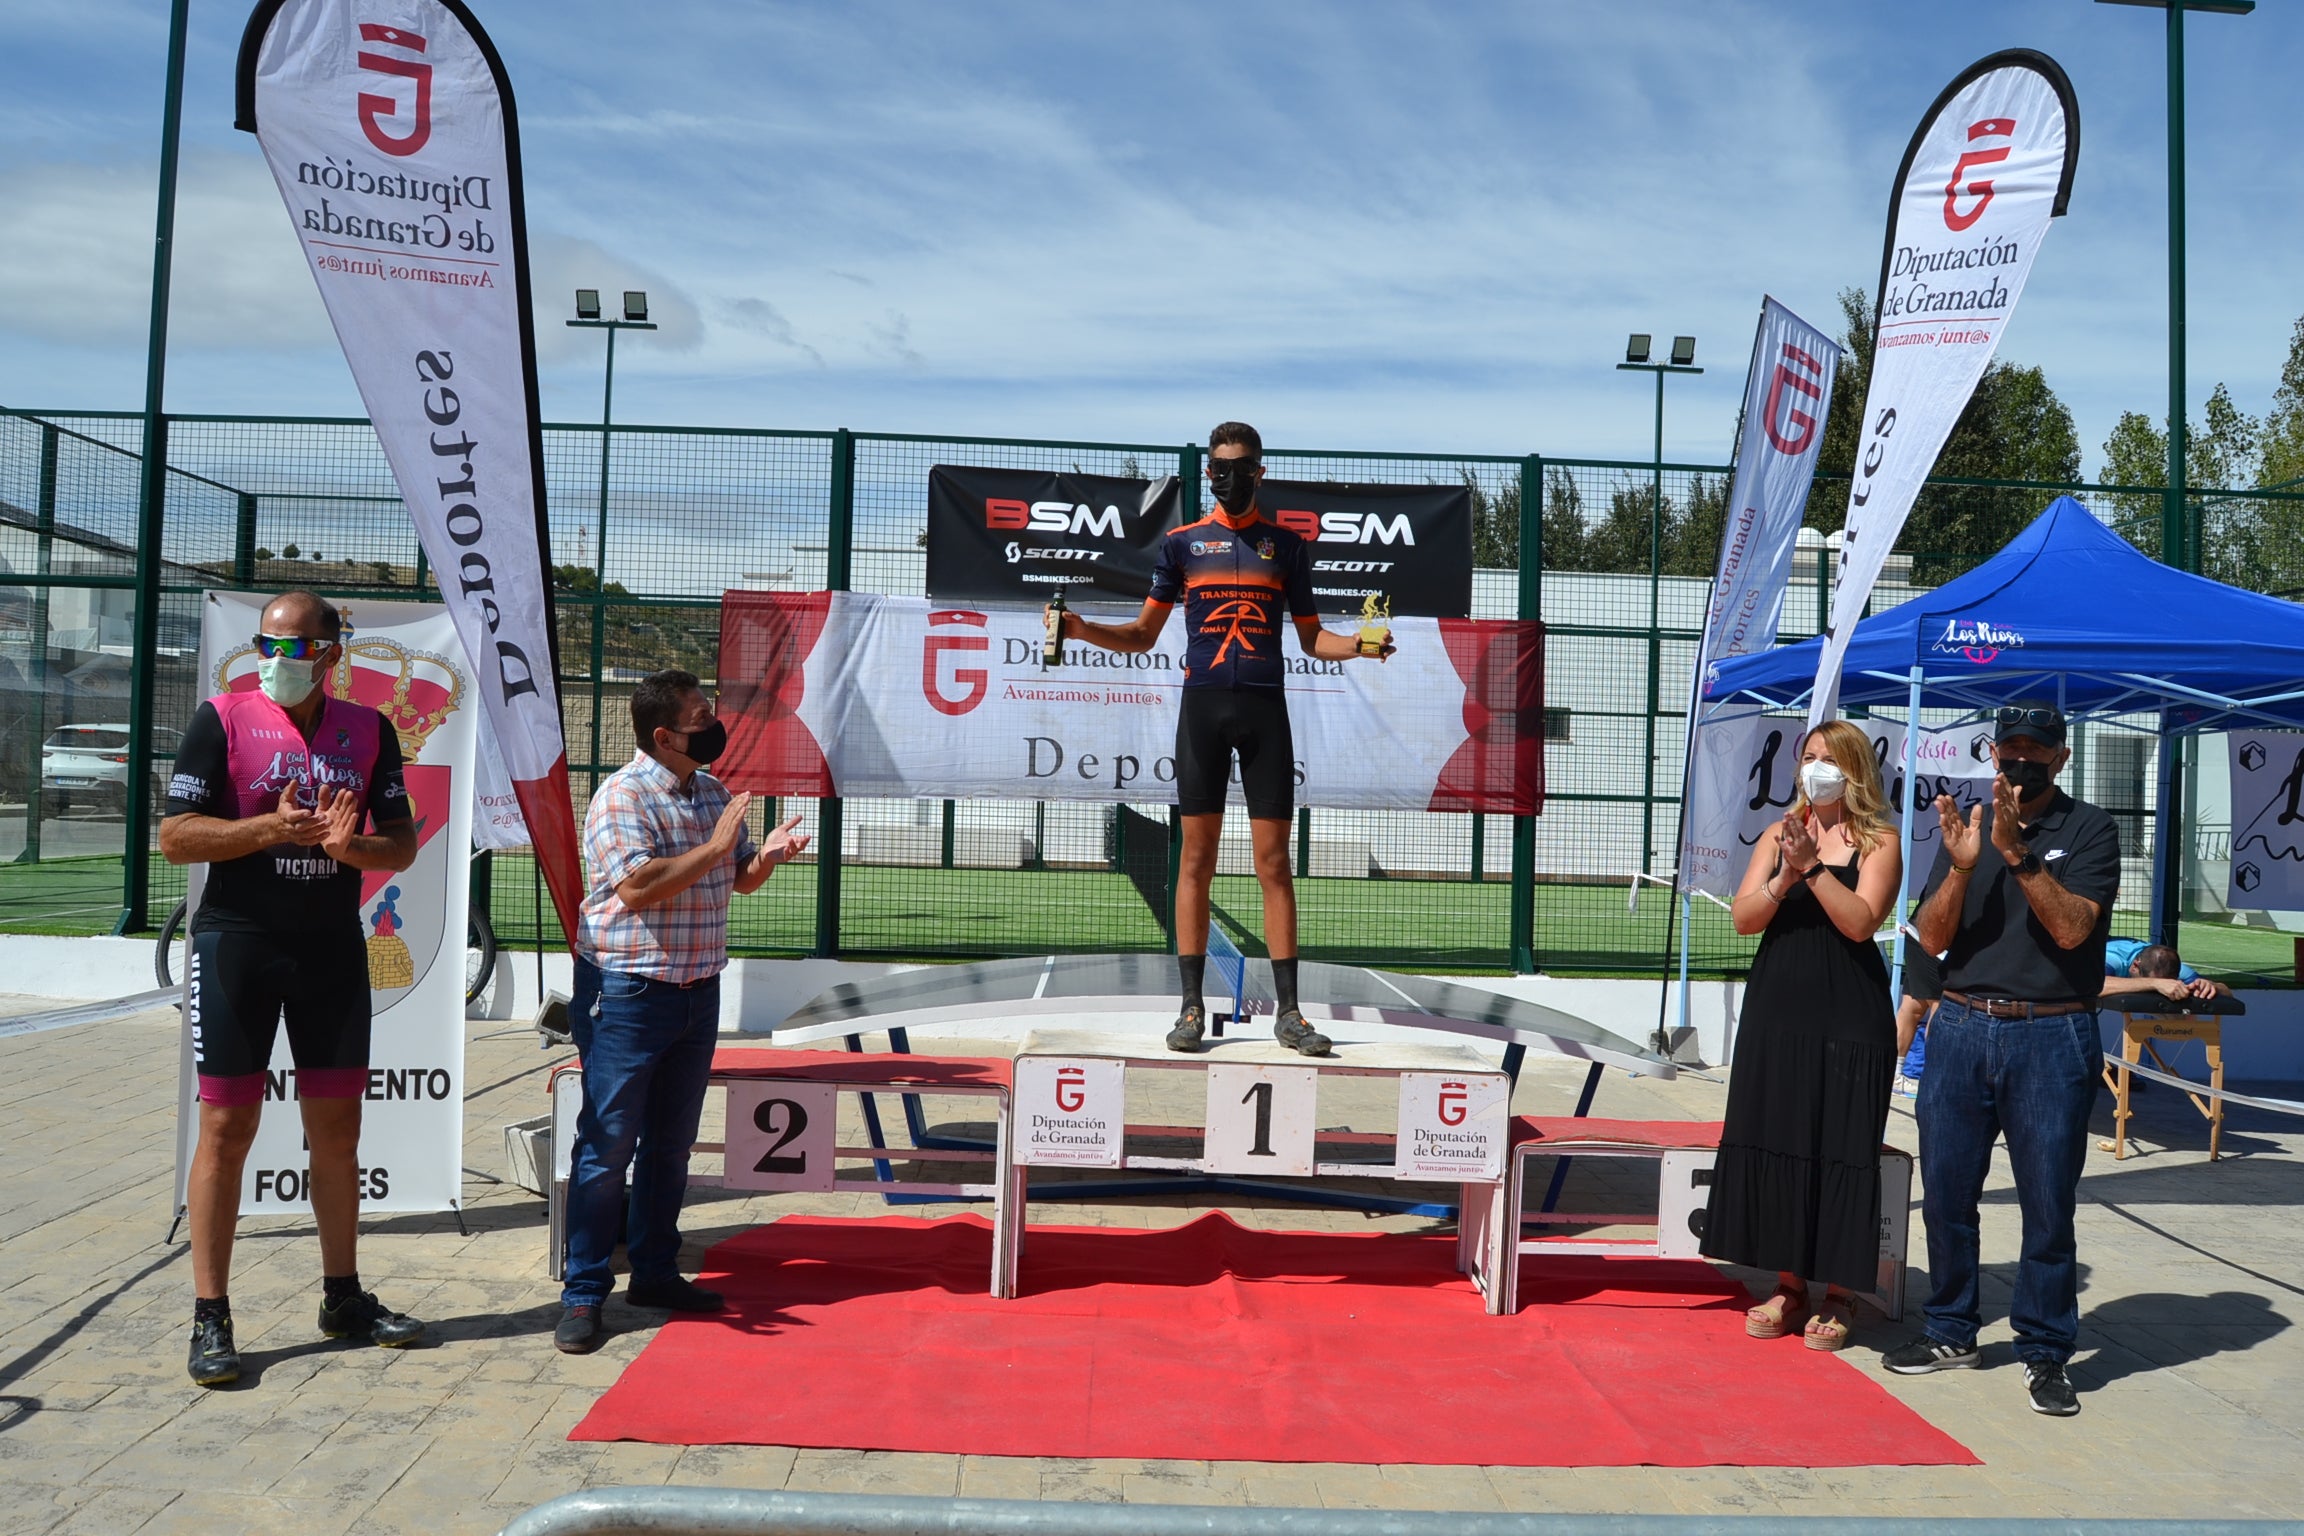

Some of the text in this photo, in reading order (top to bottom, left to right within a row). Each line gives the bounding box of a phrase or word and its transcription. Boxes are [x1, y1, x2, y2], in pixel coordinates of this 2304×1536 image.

[1892, 236, 2018, 281] Diputación
[1884, 275, 2008, 317] de Granada
[1935, 328, 1990, 347] junt@s
[986, 498, 1125, 538] BSM
[1276, 510, 1415, 546] BSM
[1023, 548, 1104, 561] SCOTT
[1312, 560, 1394, 573] SCOTT
[1022, 574, 1094, 584] BSMBIKES.COM
[1200, 590, 1272, 600] TRANSPORTES
[1312, 587, 1382, 597] BSMBIKES.COM
[1242, 626, 1272, 635] TORRES
[1727, 588, 1760, 658] portes
[1946, 619, 1977, 645] Los
[1283, 657, 1345, 676] nada
[1003, 684, 1162, 705] Avanzamos junt@s
[1901, 735, 1957, 761] Cclista
[270, 751, 309, 784] Los
[1022, 736, 1306, 789] Depots
[276, 858, 338, 875] VICTORIA
[1032, 1115, 1106, 1130] Diputación
[1241, 1082, 1277, 1157] 1
[752, 1098, 808, 1175] 2
[1031, 1130, 1105, 1144] de Granada
[1414, 1129, 1487, 1144] Diputación
[1413, 1144, 1486, 1159] de Granada
[1415, 1163, 1457, 1172] Avanzamos
